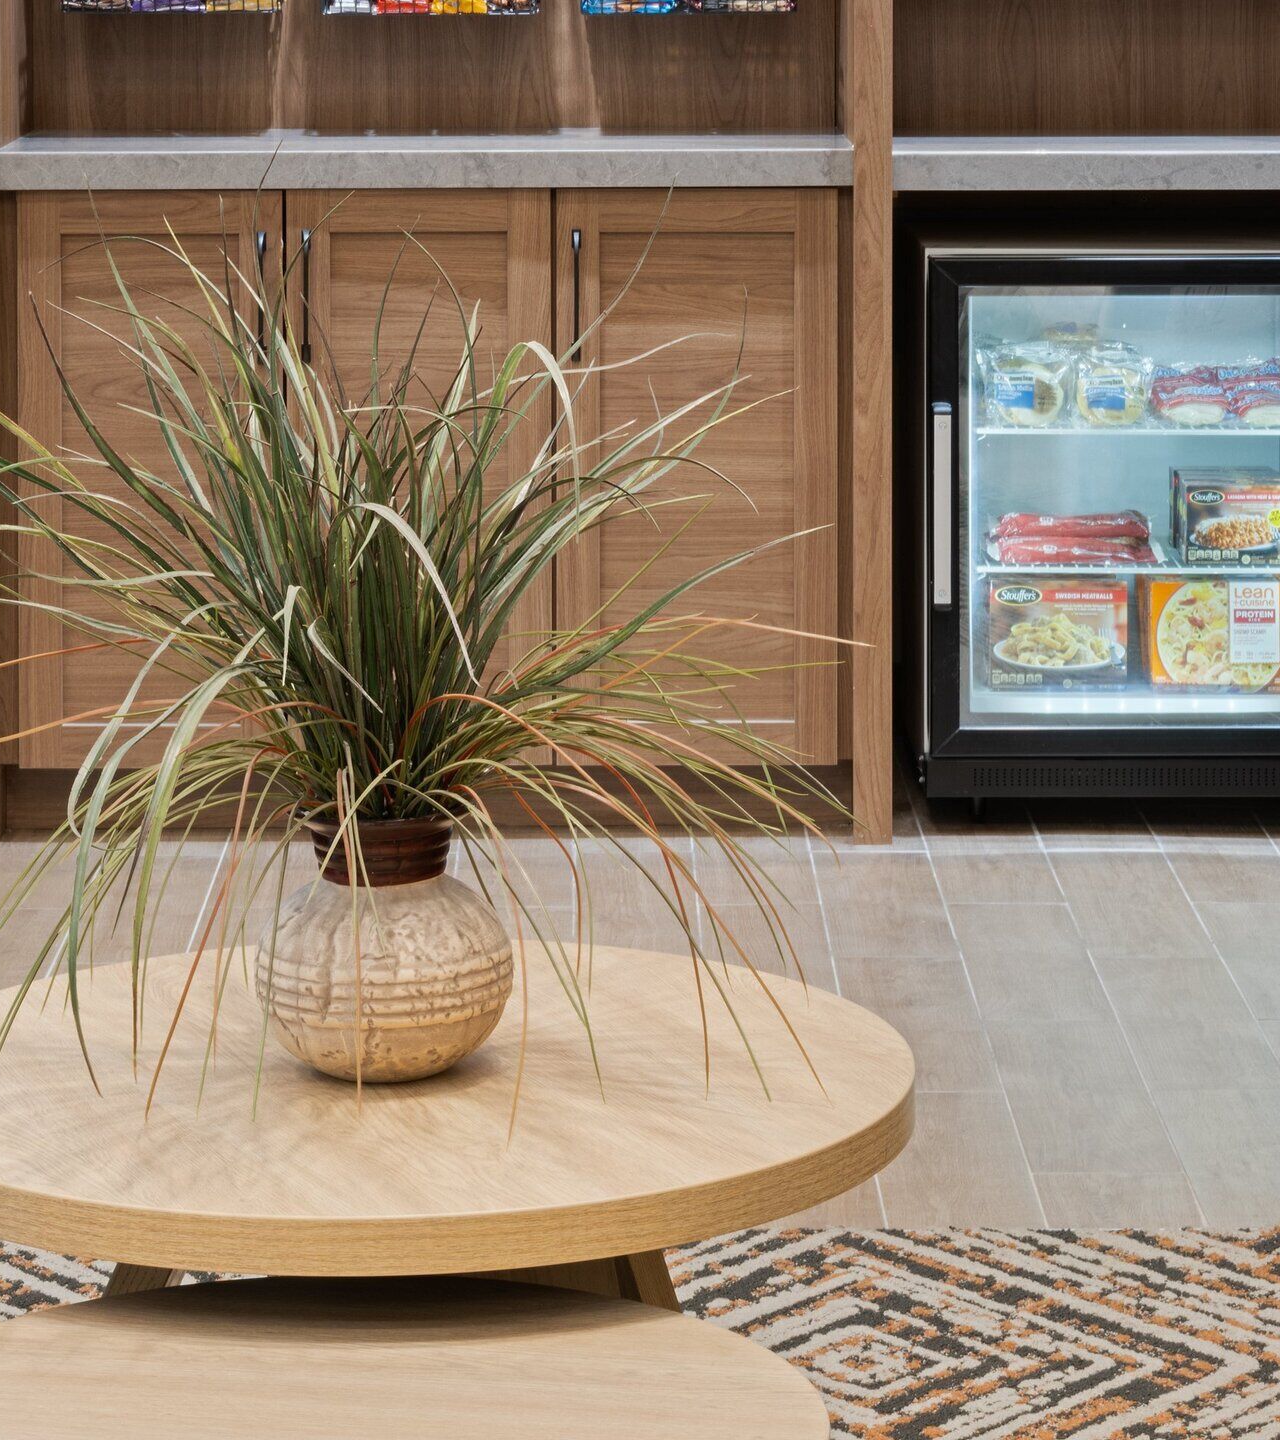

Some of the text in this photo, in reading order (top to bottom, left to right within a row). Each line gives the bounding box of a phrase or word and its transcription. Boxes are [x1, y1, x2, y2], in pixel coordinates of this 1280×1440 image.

[1193, 491, 1221, 503] Stouffer's
[1000, 589, 1037, 602] Stouffer's
[1234, 587, 1274, 599] Lean
[1236, 610, 1274, 618] PROTEIN
